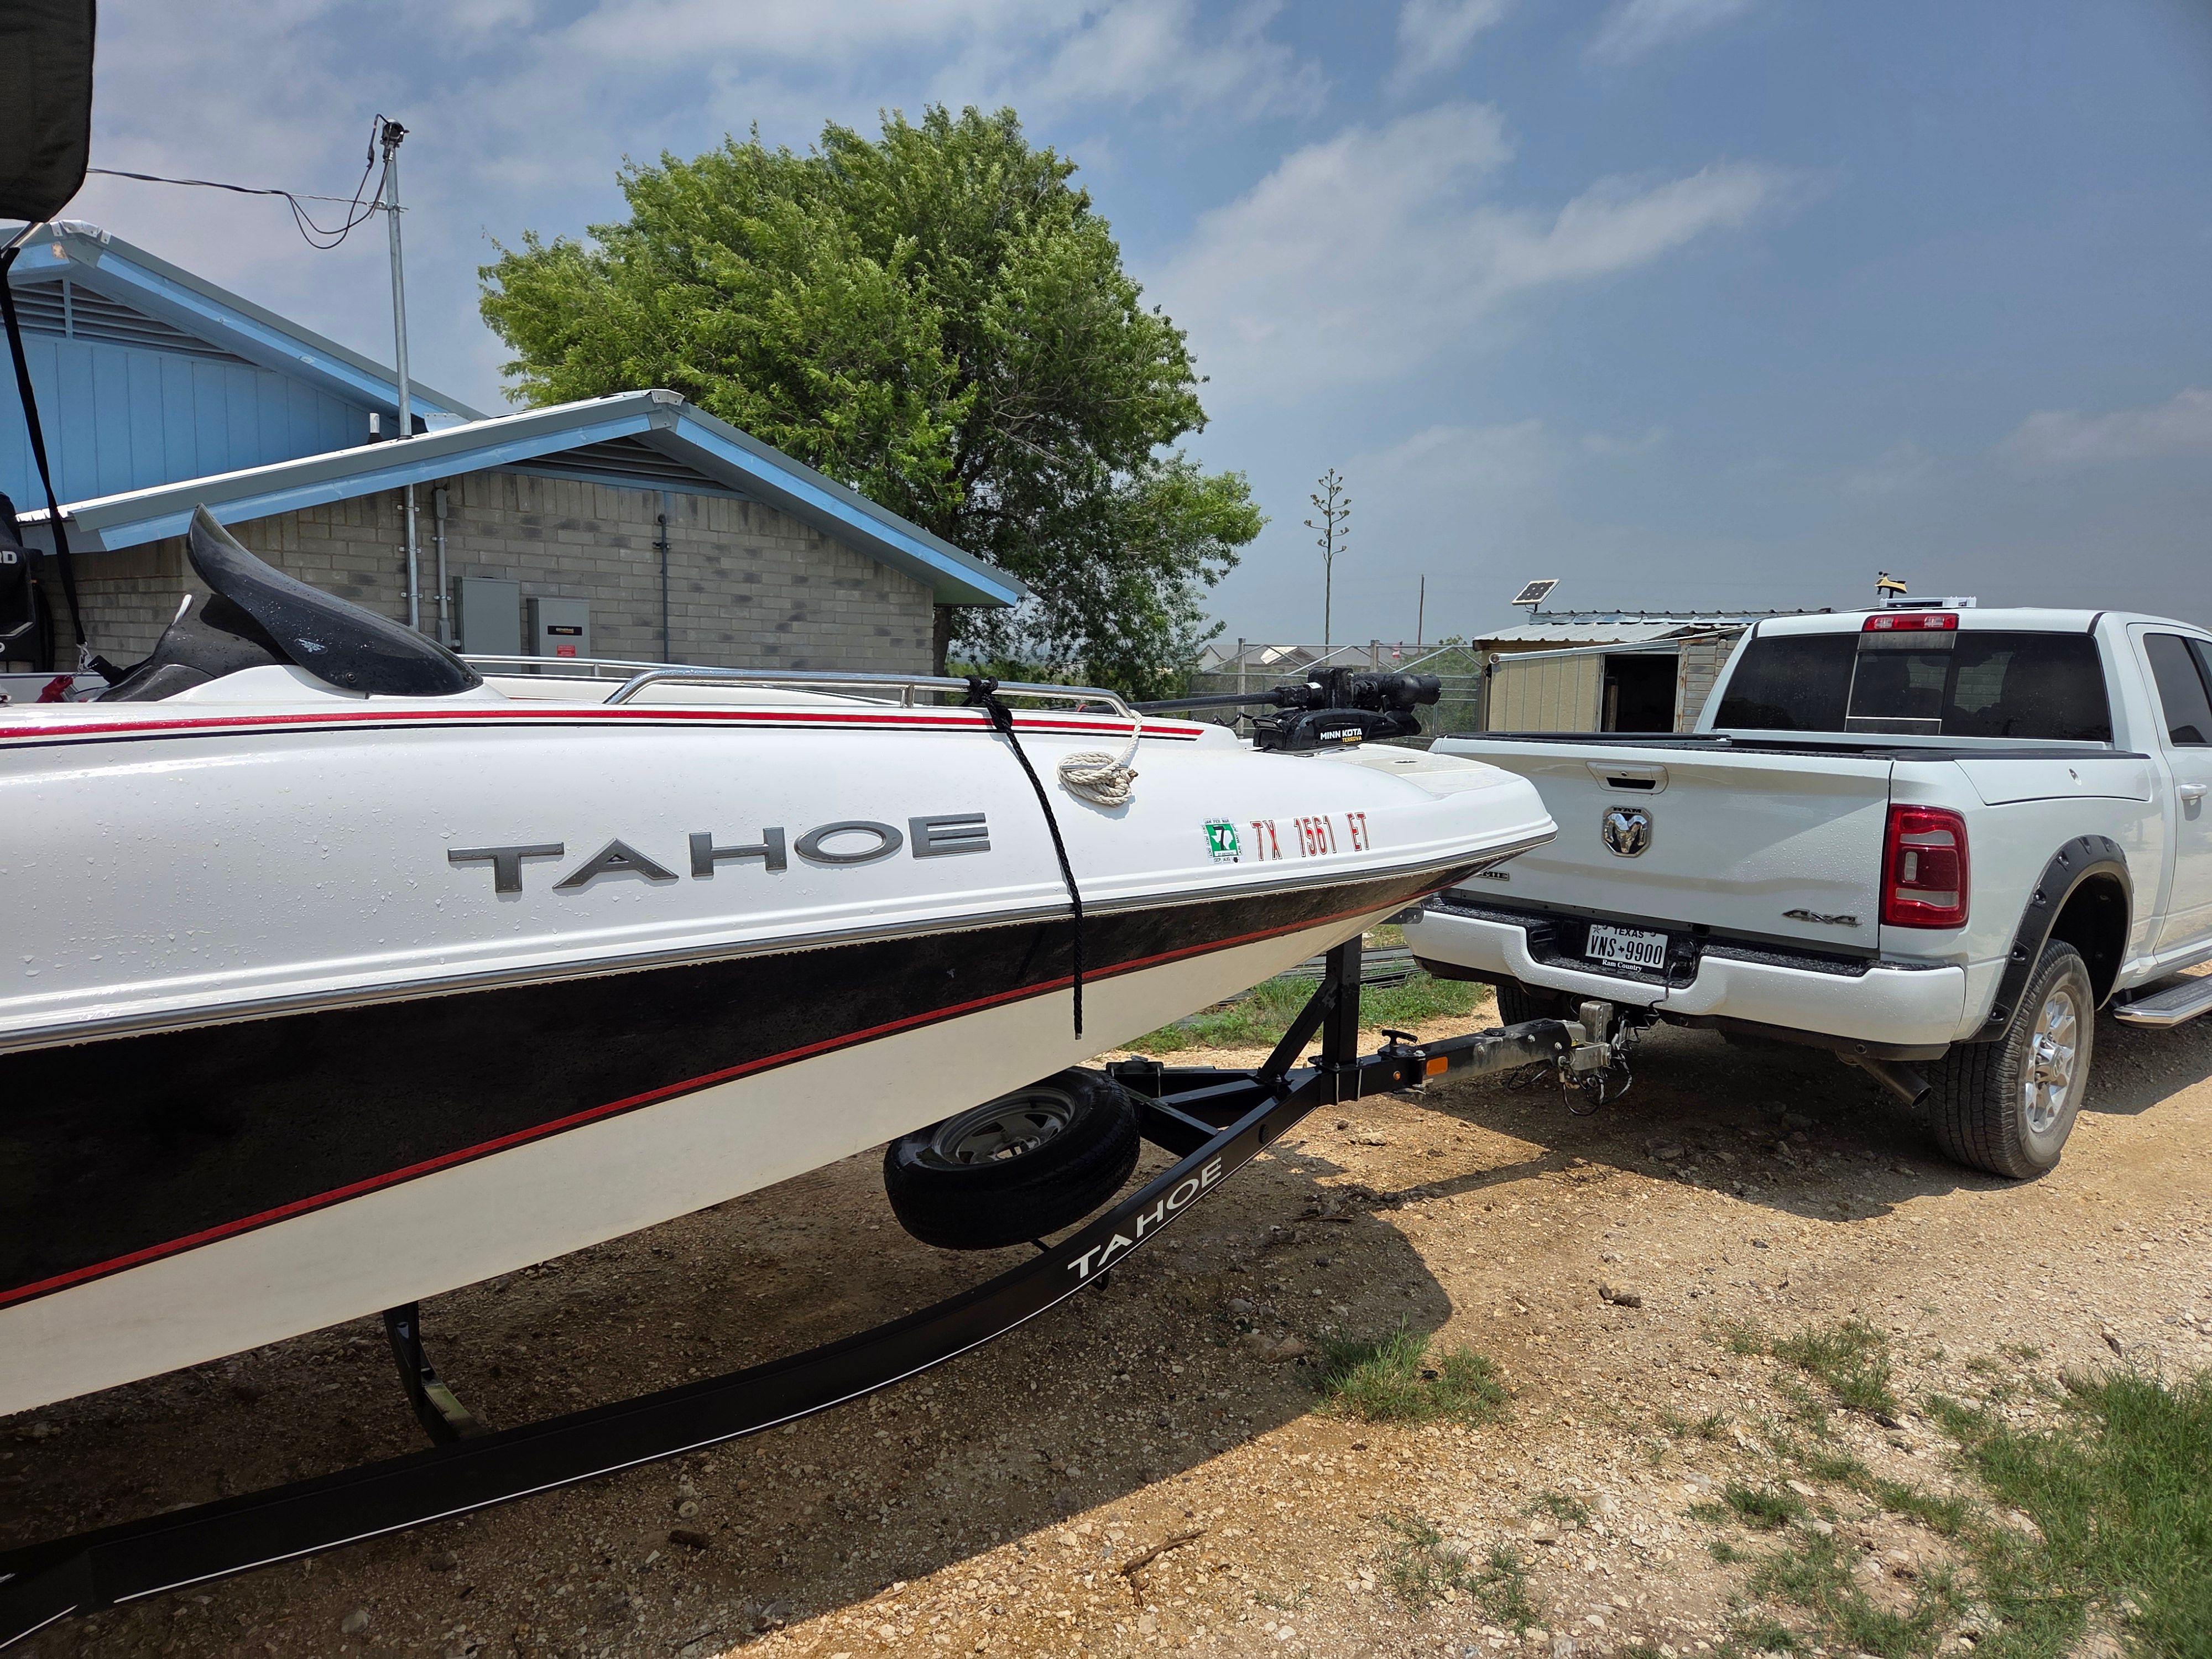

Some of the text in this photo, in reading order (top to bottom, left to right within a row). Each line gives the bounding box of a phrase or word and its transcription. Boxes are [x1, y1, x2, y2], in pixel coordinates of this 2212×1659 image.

[1320, 728, 1363, 740] MINN KOTA
[1212, 826, 1225, 851] 7
[1250, 812, 1369, 861] TX 1561 ET
[447, 812, 991, 893] TAHOE
[1613, 927, 1644, 938] TEXAS
[1590, 935, 1663, 964] VNS 9900
[1602, 959, 1642, 972] Ram Country
[1067, 1157, 1222, 1279] TAHOE
